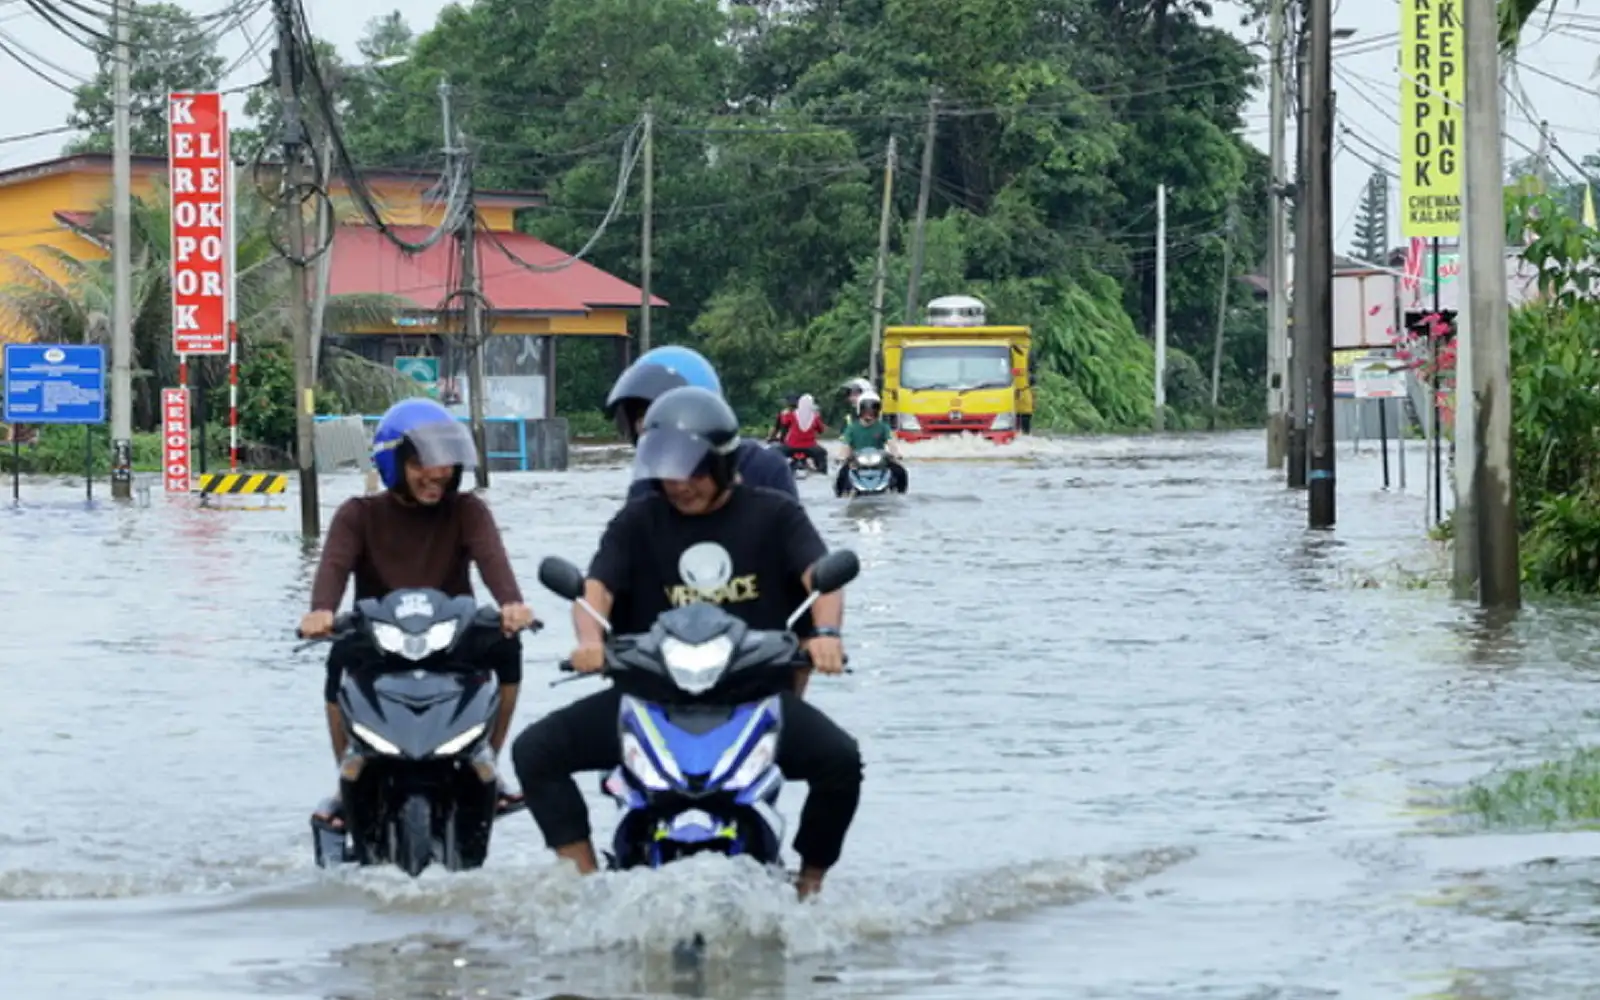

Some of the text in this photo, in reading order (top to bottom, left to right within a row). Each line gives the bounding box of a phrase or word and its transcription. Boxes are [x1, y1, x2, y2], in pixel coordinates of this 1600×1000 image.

[1438, 3, 1456, 175] KEPING
[171, 98, 200, 330] KEROPOK
[199, 132, 225, 297] LEKOR
[168, 392, 188, 491] KEROPOK
